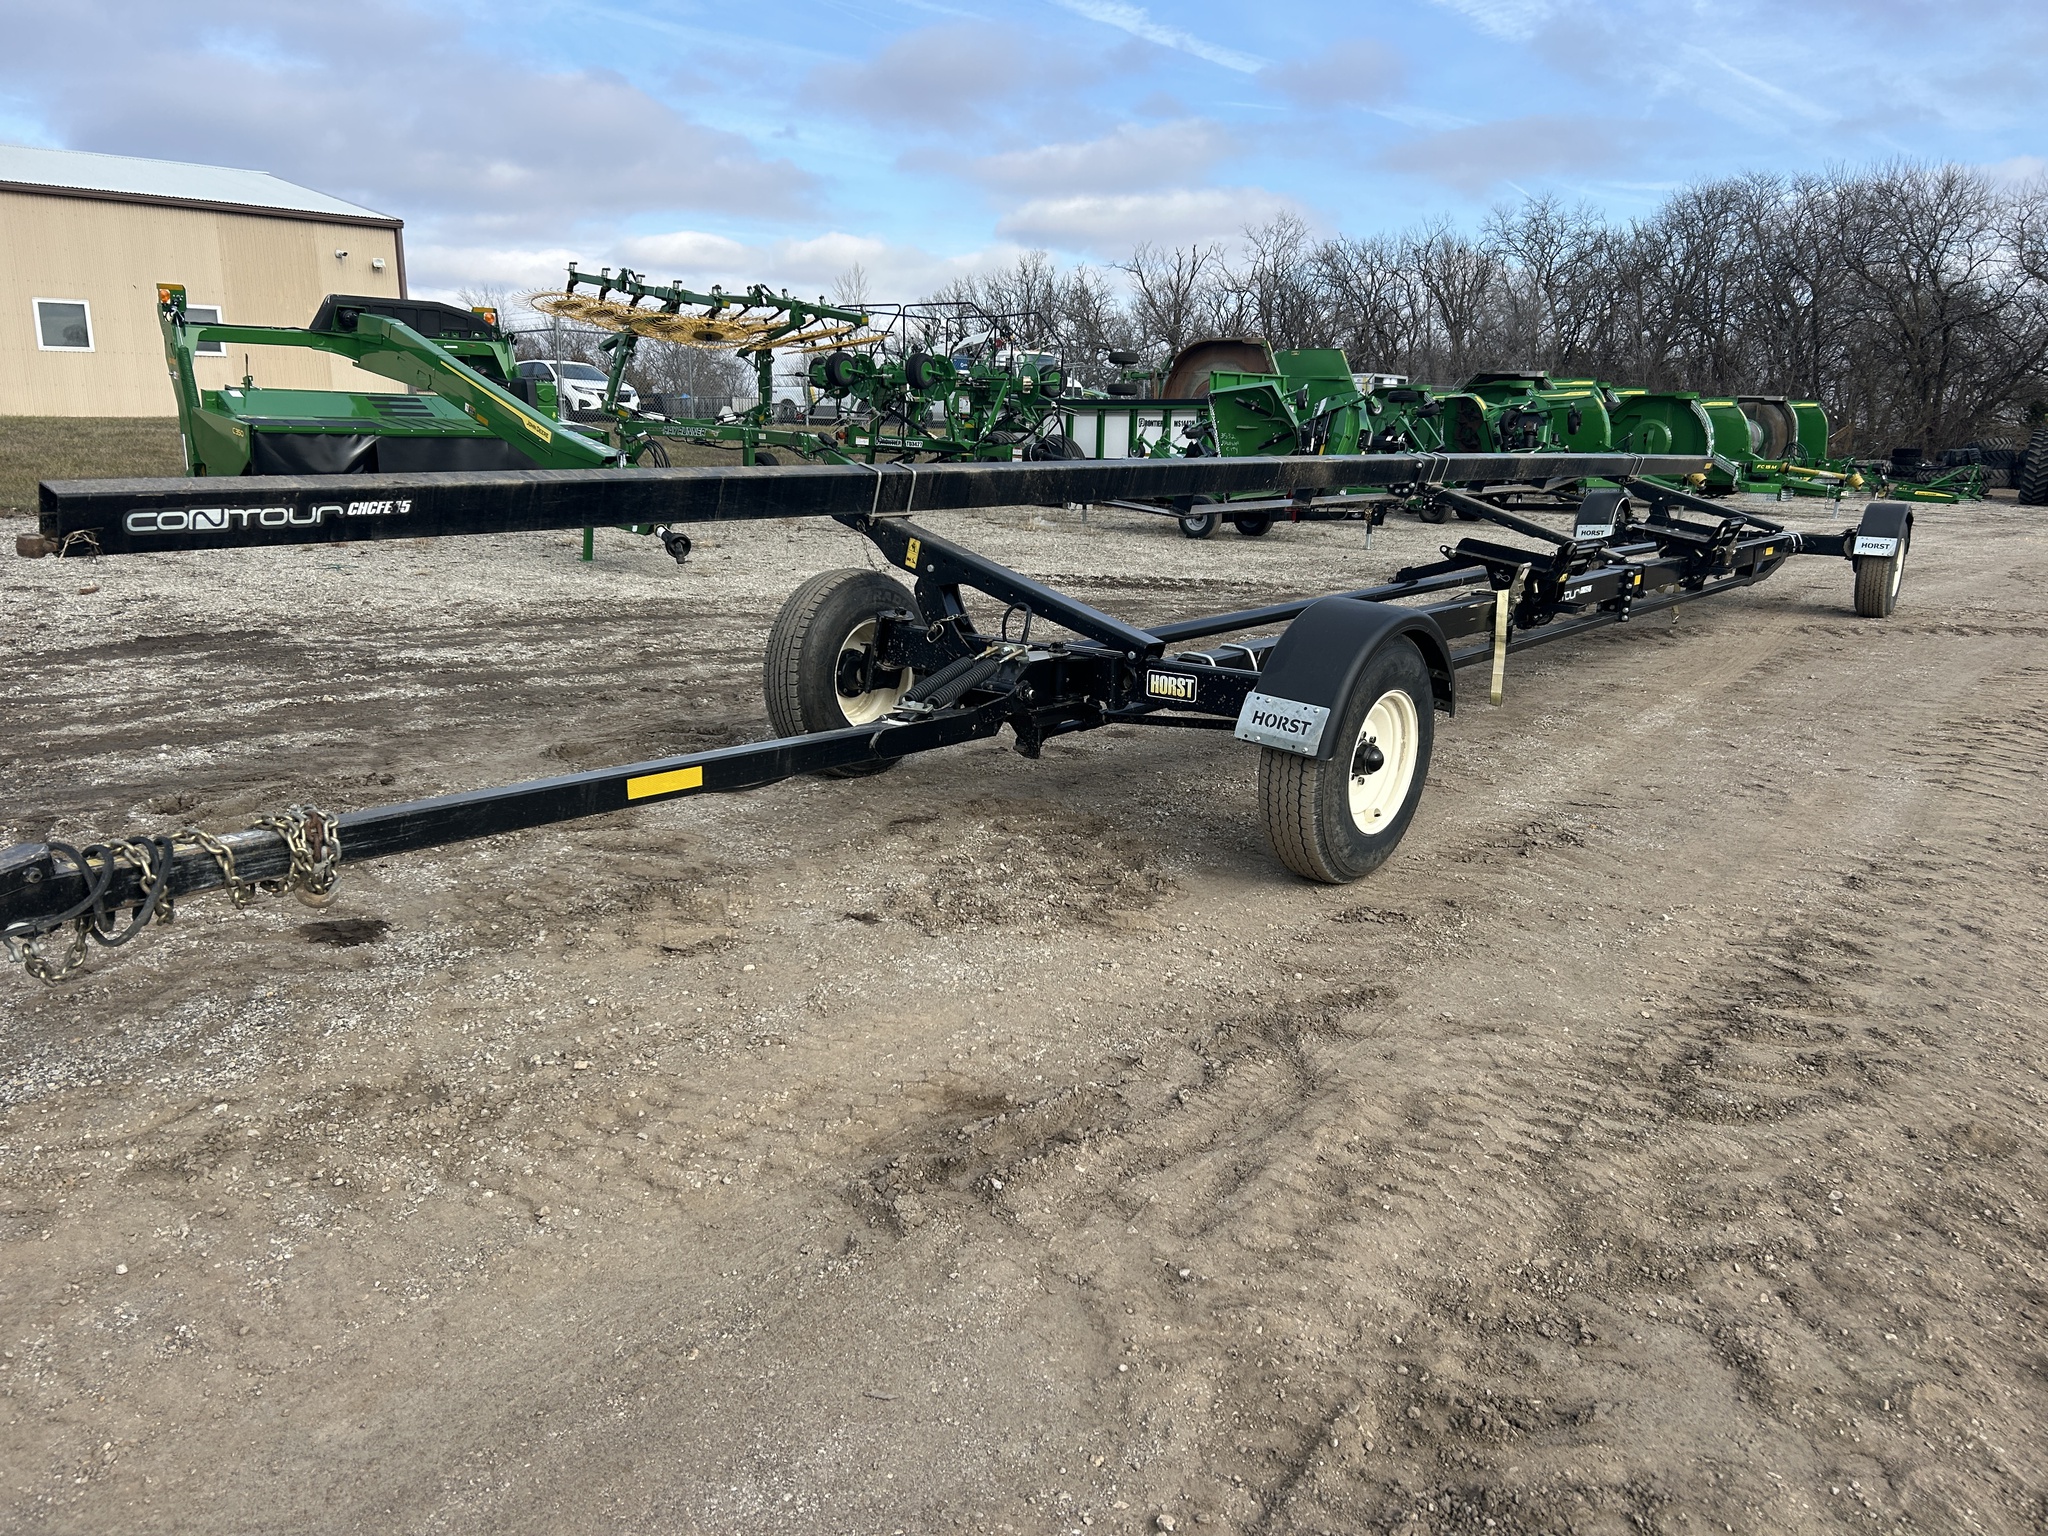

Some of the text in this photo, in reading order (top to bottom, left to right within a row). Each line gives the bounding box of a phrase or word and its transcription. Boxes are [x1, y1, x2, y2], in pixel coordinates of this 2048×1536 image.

[1861, 542, 1891, 550] HORST
[1150, 674, 1195, 699] HORST
[1251, 710, 1312, 736] HORST
